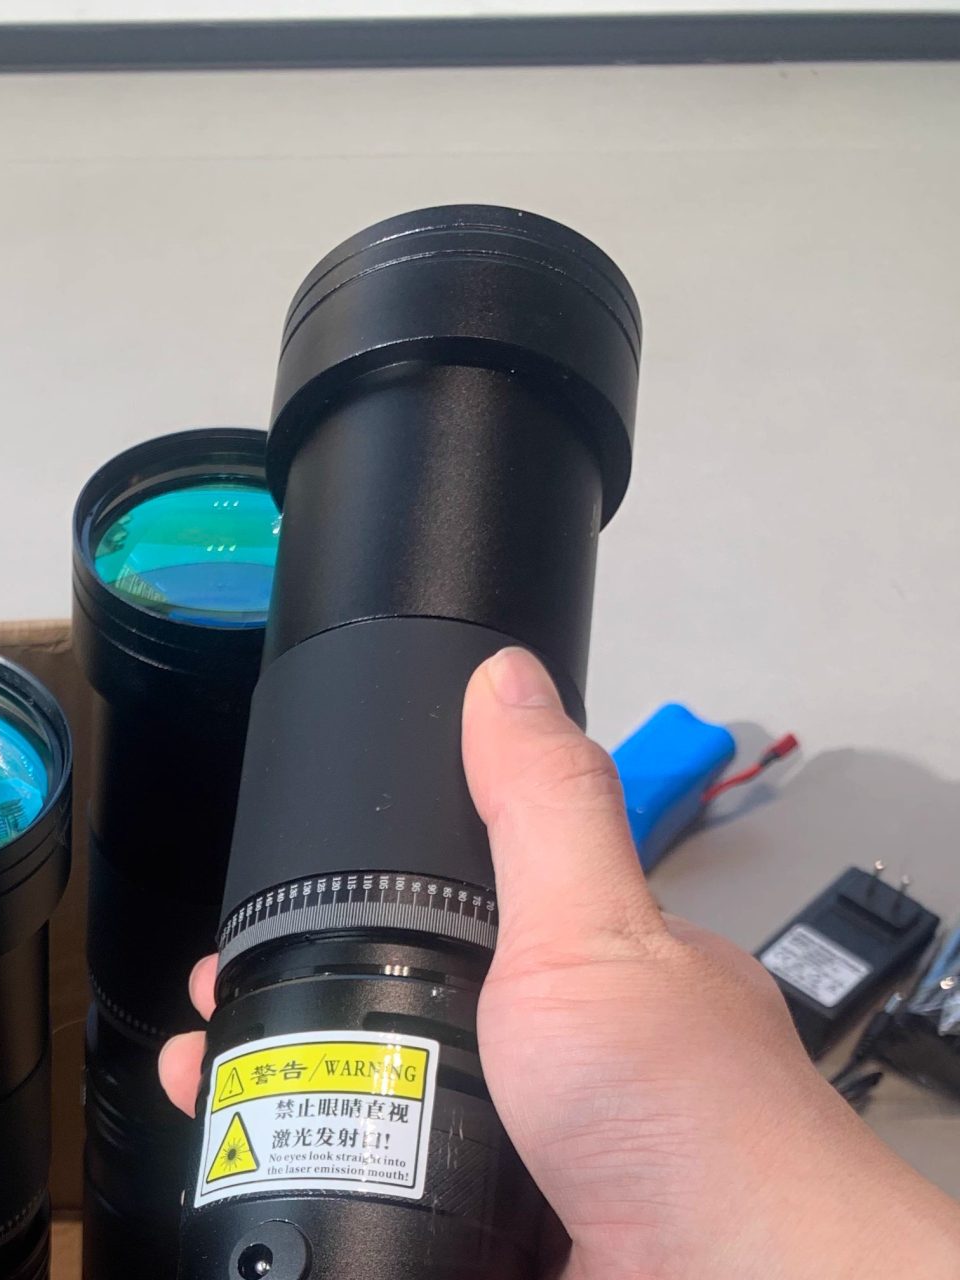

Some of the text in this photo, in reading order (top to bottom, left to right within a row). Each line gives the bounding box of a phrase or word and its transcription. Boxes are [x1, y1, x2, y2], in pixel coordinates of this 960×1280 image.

[289, 884, 298, 899] 135
[303, 880, 312, 896] 130
[317, 878, 326, 893] 125
[331, 876, 341, 891] 120
[347, 875, 357, 890] 115
[362, 875, 373, 890] 110
[379, 875, 389, 890] 105
[395, 876, 405, 891] 100
[411, 881, 421, 893] 95
[427, 883, 437, 895] 90
[442, 886, 452, 898] 85
[458, 890, 467, 902] 80
[472, 895, 481, 906] 75
[486, 900, 495, 911] 70
[274, 1098, 410, 1124] 禁止眼睛直视
[269, 1153, 281, 1162] No
[284, 1152, 306, 1163] eyes
[309, 1151, 334, 1162] look
[383, 1156, 406, 1168] into
[267, 1164, 409, 1182] the laser emission mouth!
